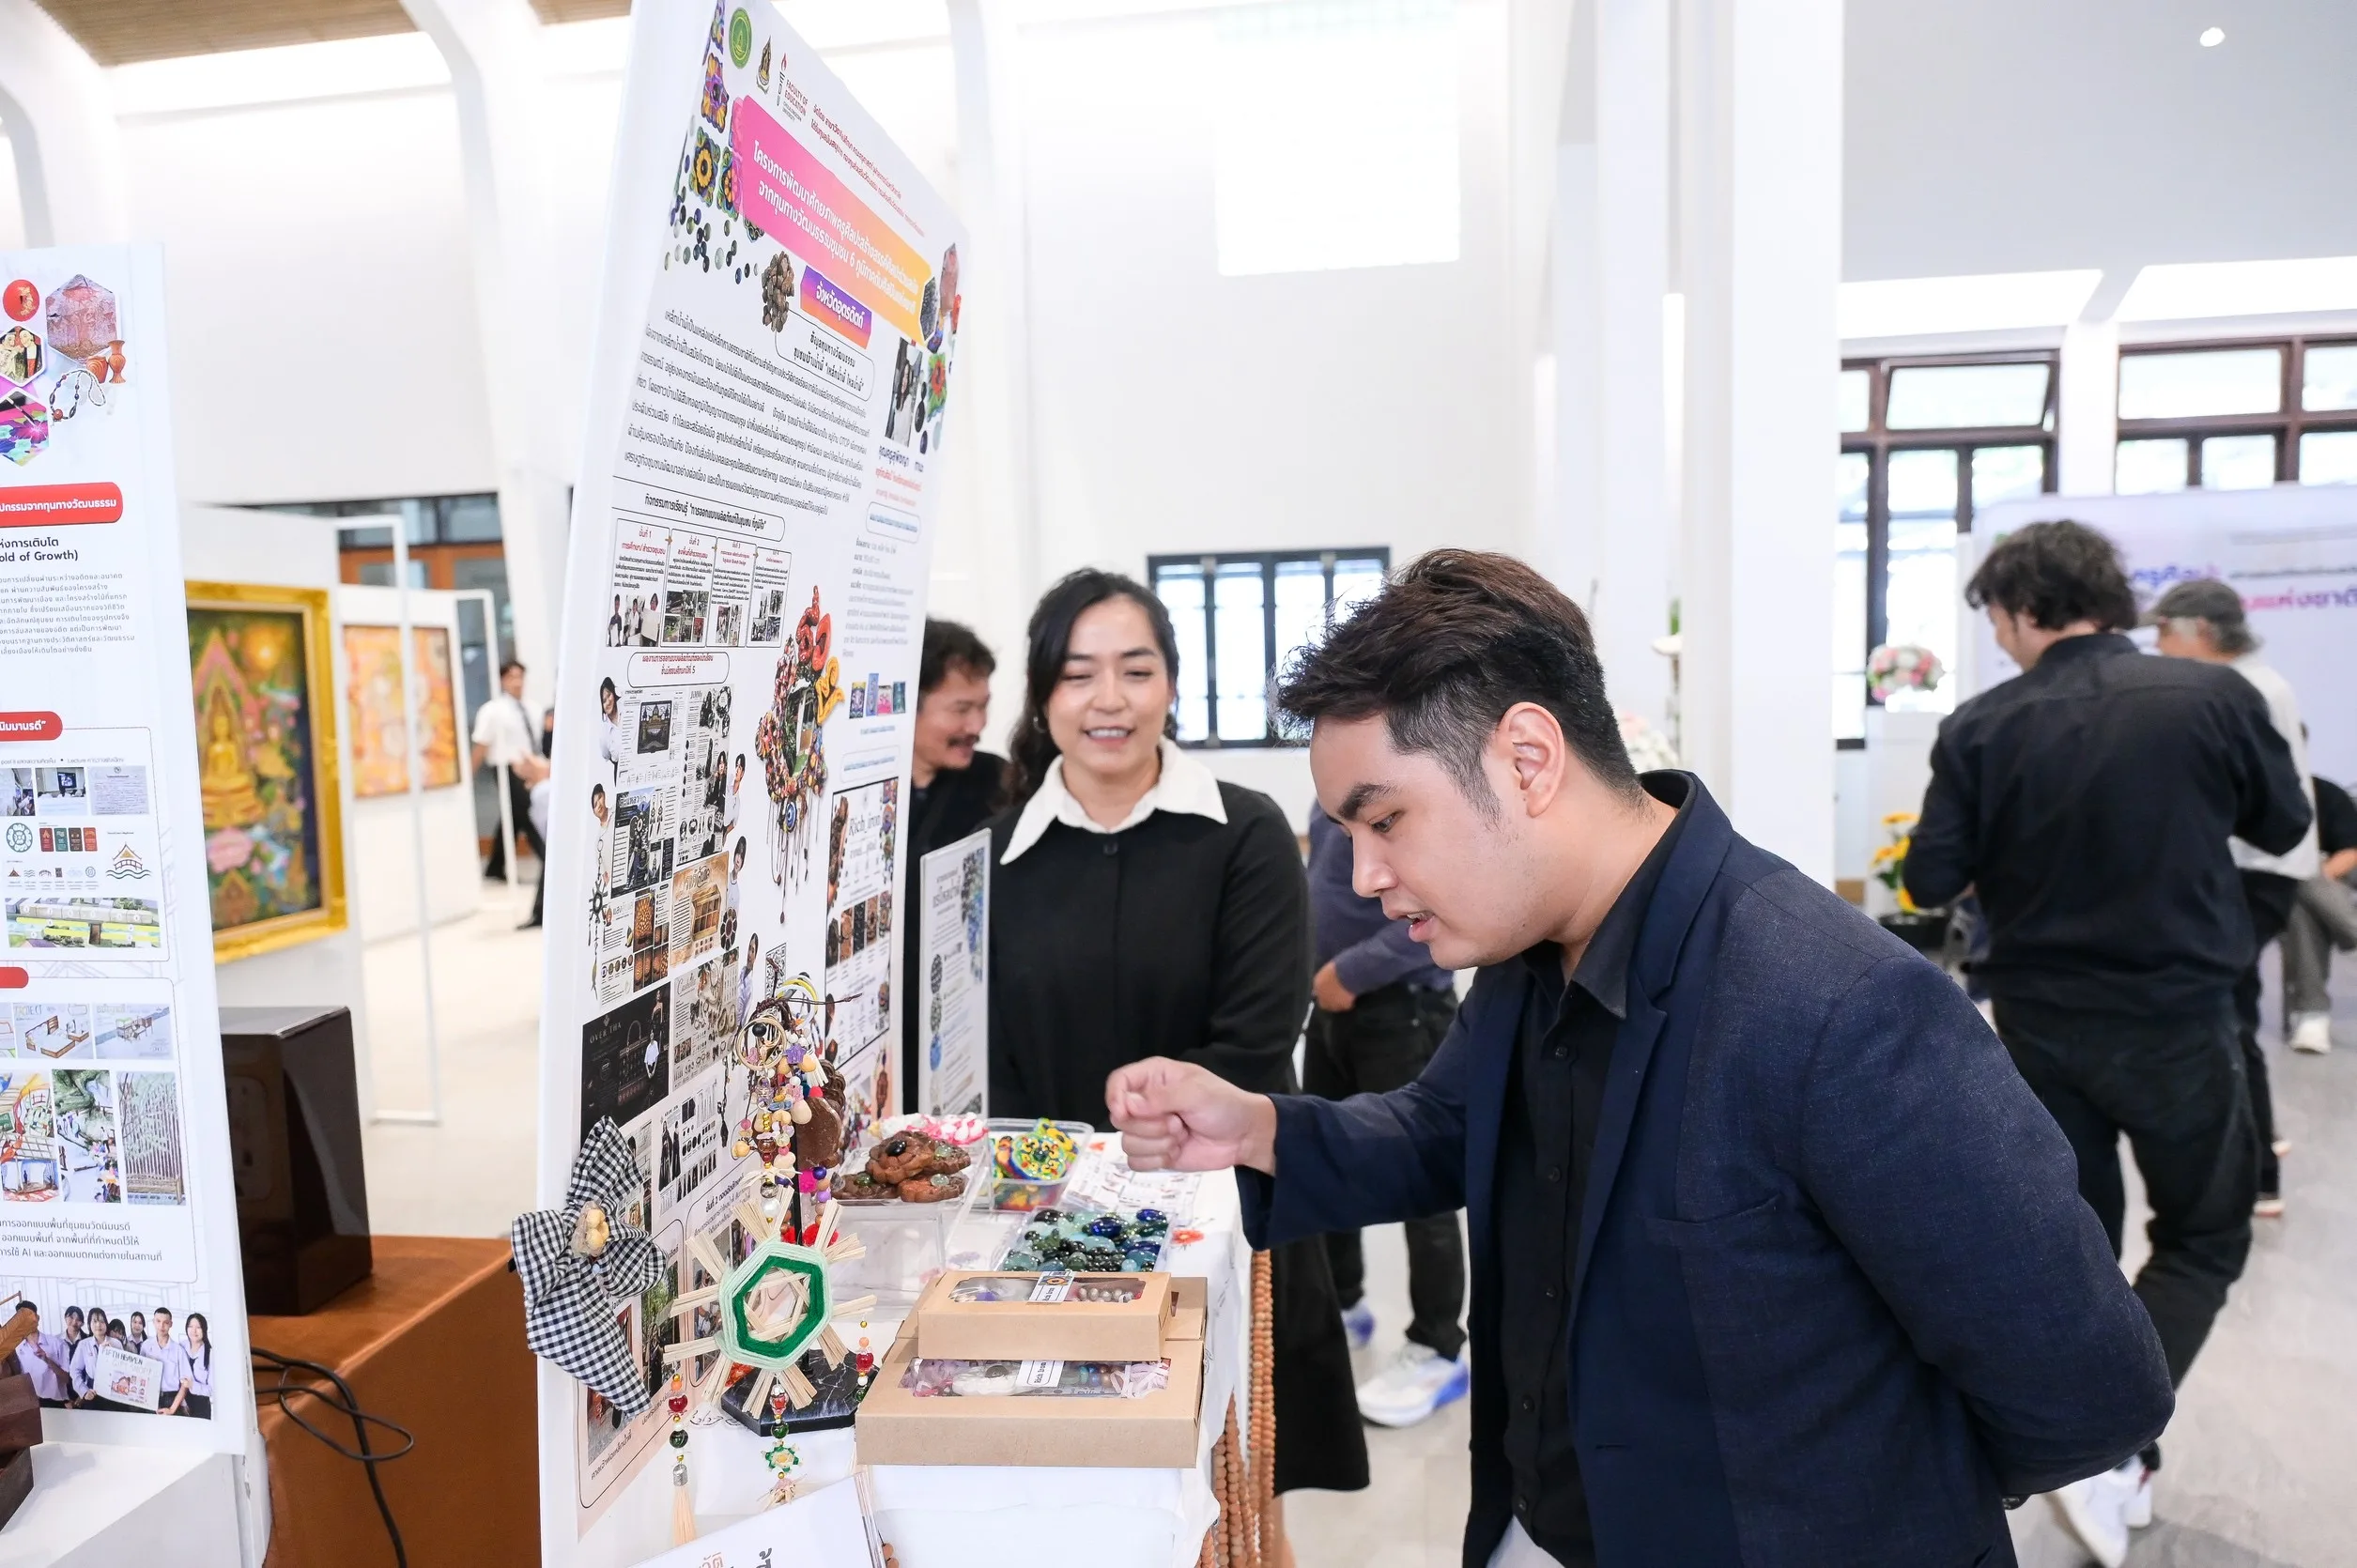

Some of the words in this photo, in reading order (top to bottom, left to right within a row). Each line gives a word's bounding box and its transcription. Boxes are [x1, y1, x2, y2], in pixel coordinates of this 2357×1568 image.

[20, 551, 30, 561] of
[35, 550, 78, 561] Growth)
[0, 1217, 131, 1232] การออกแบบพื้นที่ชุมชนวัดนิมนรดี
[2, 1231, 54, 1243] ออกแบบพื้นที่
[22, 1248, 31, 1257] AI
[34, 1249, 162, 1262] และออกแบบตกแต่งภายในสถานที่
